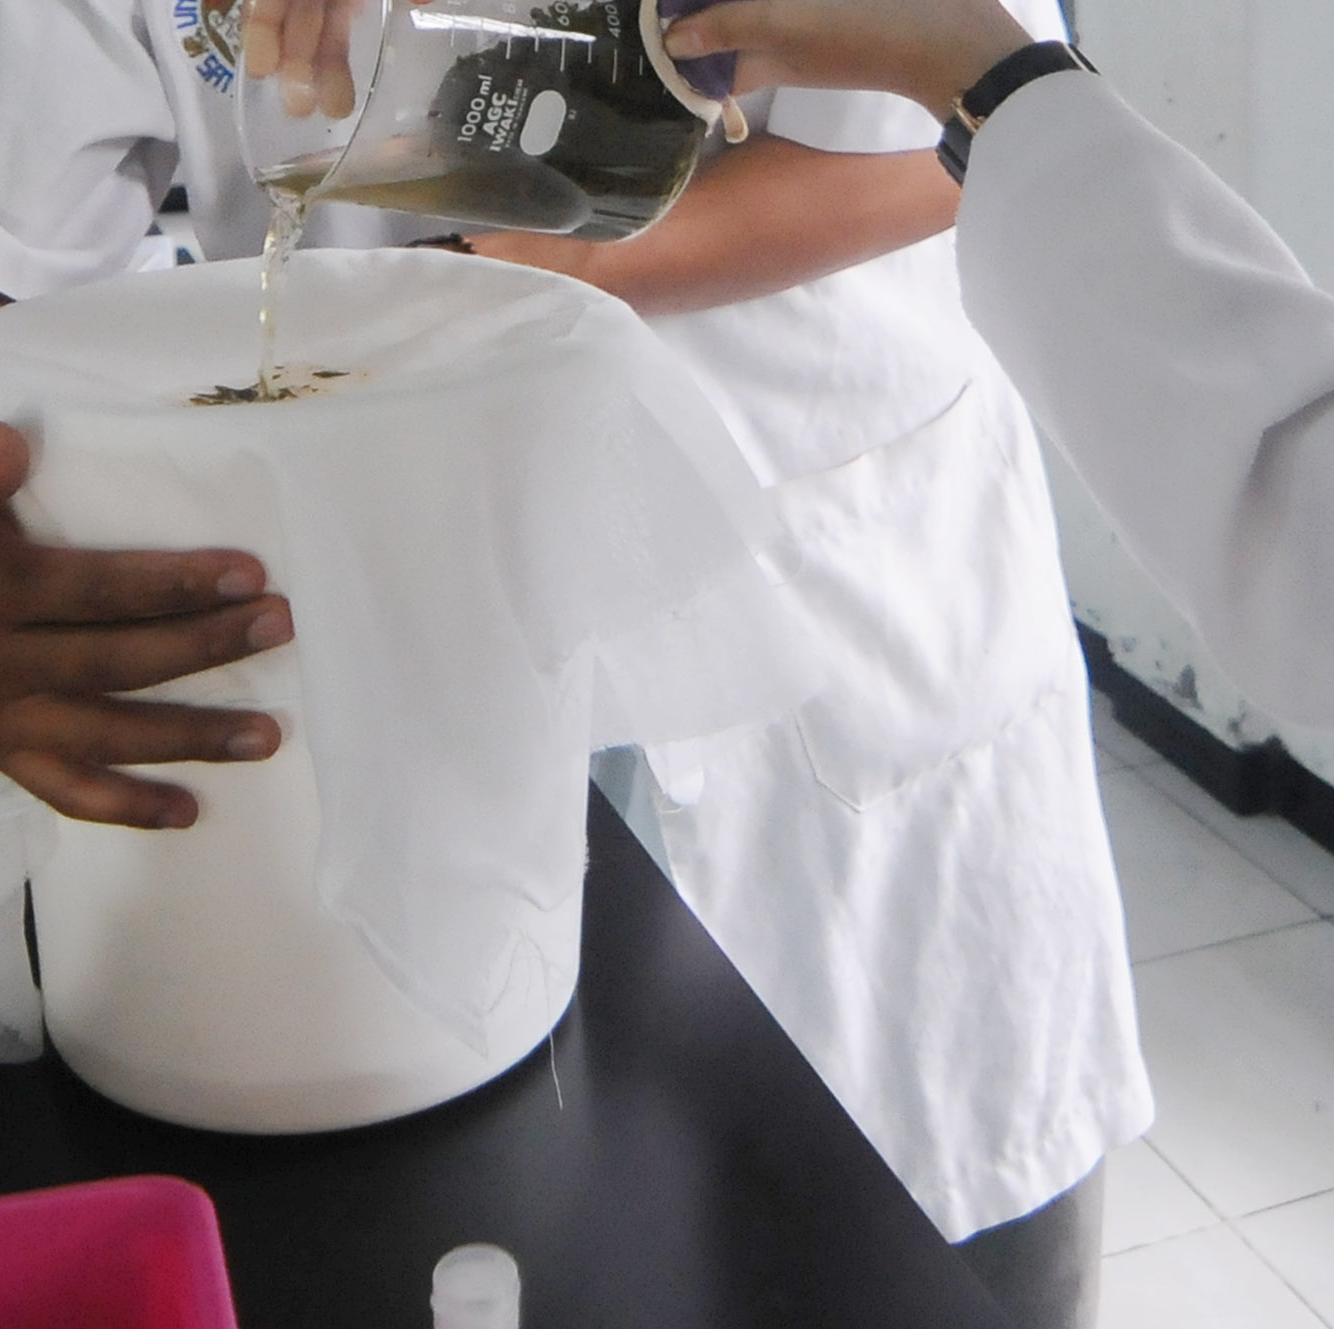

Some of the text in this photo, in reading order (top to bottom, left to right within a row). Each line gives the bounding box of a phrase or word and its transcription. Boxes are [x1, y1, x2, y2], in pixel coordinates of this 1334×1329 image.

[605, 3, 622, 38] 400
[457, 74, 493, 142] 1000 ml
[482, 92, 507, 136] AGC
[489, 98, 518, 152] IWAKI
